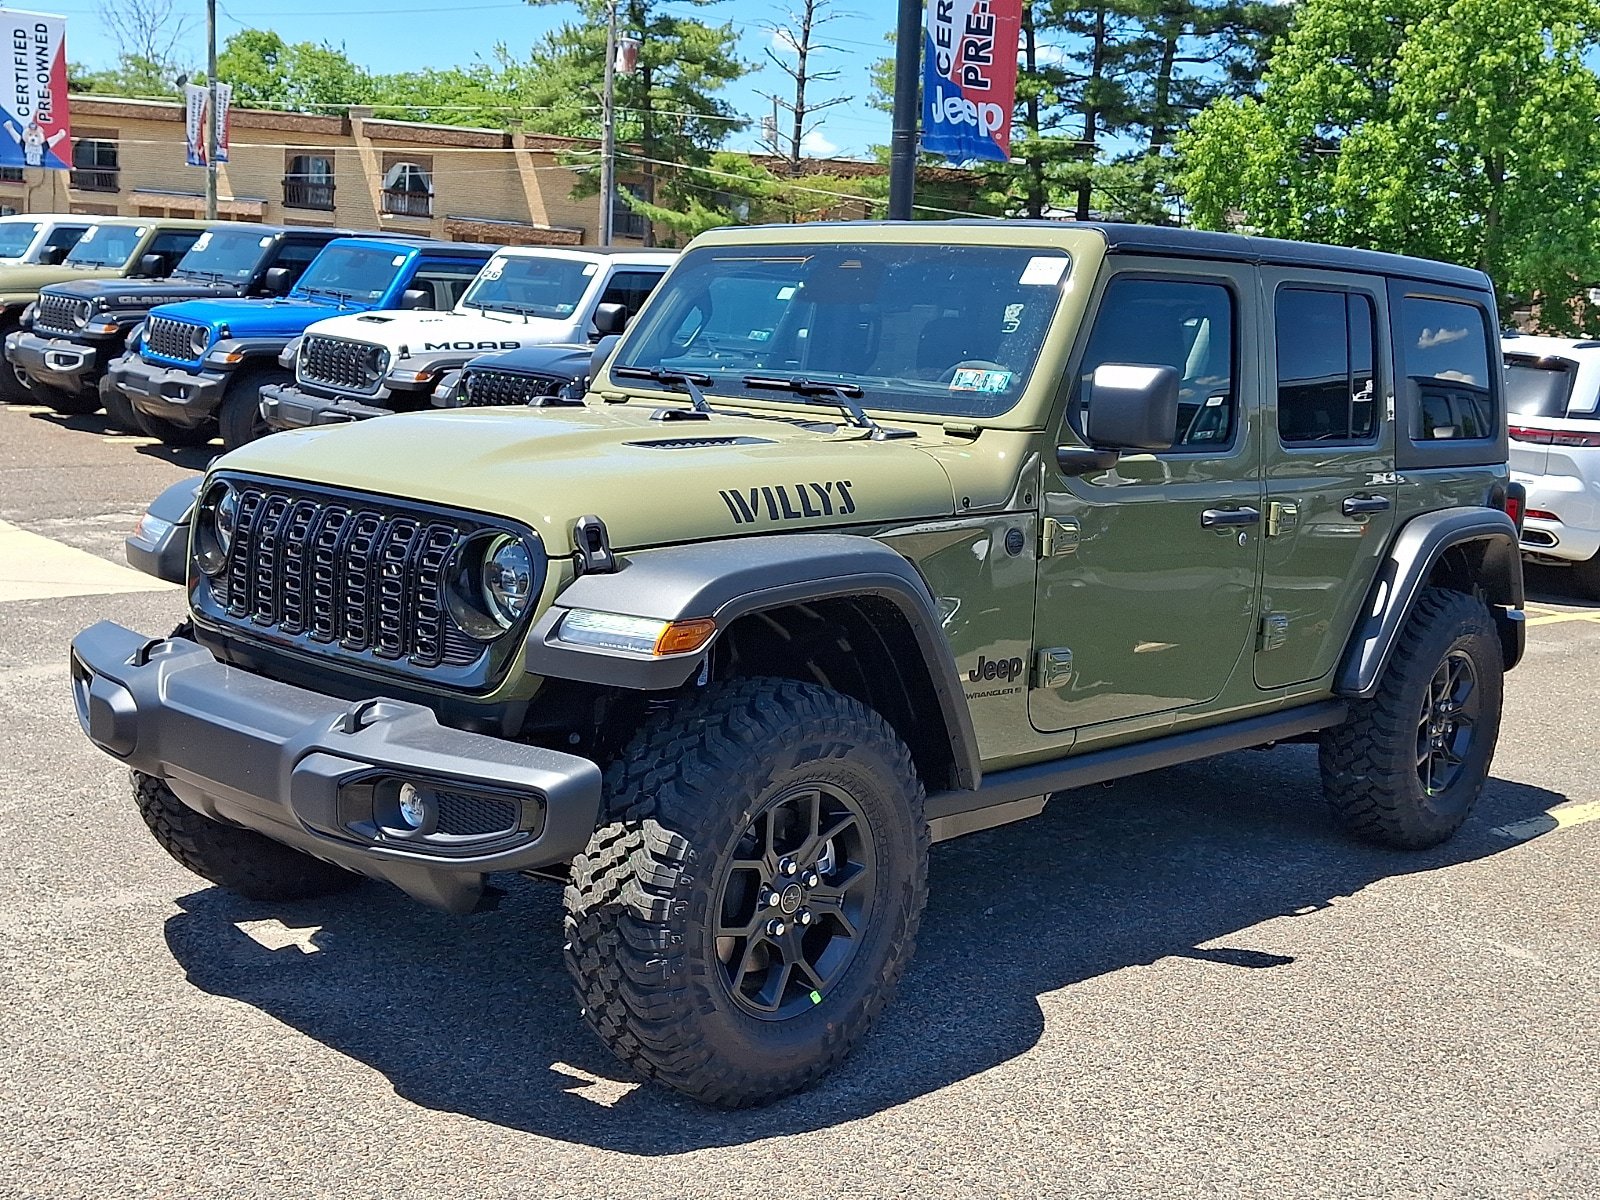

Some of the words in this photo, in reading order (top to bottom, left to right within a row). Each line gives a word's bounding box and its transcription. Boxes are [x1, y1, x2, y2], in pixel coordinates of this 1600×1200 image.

[13, 28, 30, 117] CERTIFIED
[35, 23, 51, 122] PRE-OWNED
[931, 85, 1004, 137] Jeep
[424, 341, 521, 350] MOAB
[718, 480, 856, 524] WILLYS
[969, 655, 1023, 683] Jeep
[965, 688, 1014, 700] WRANGLER
